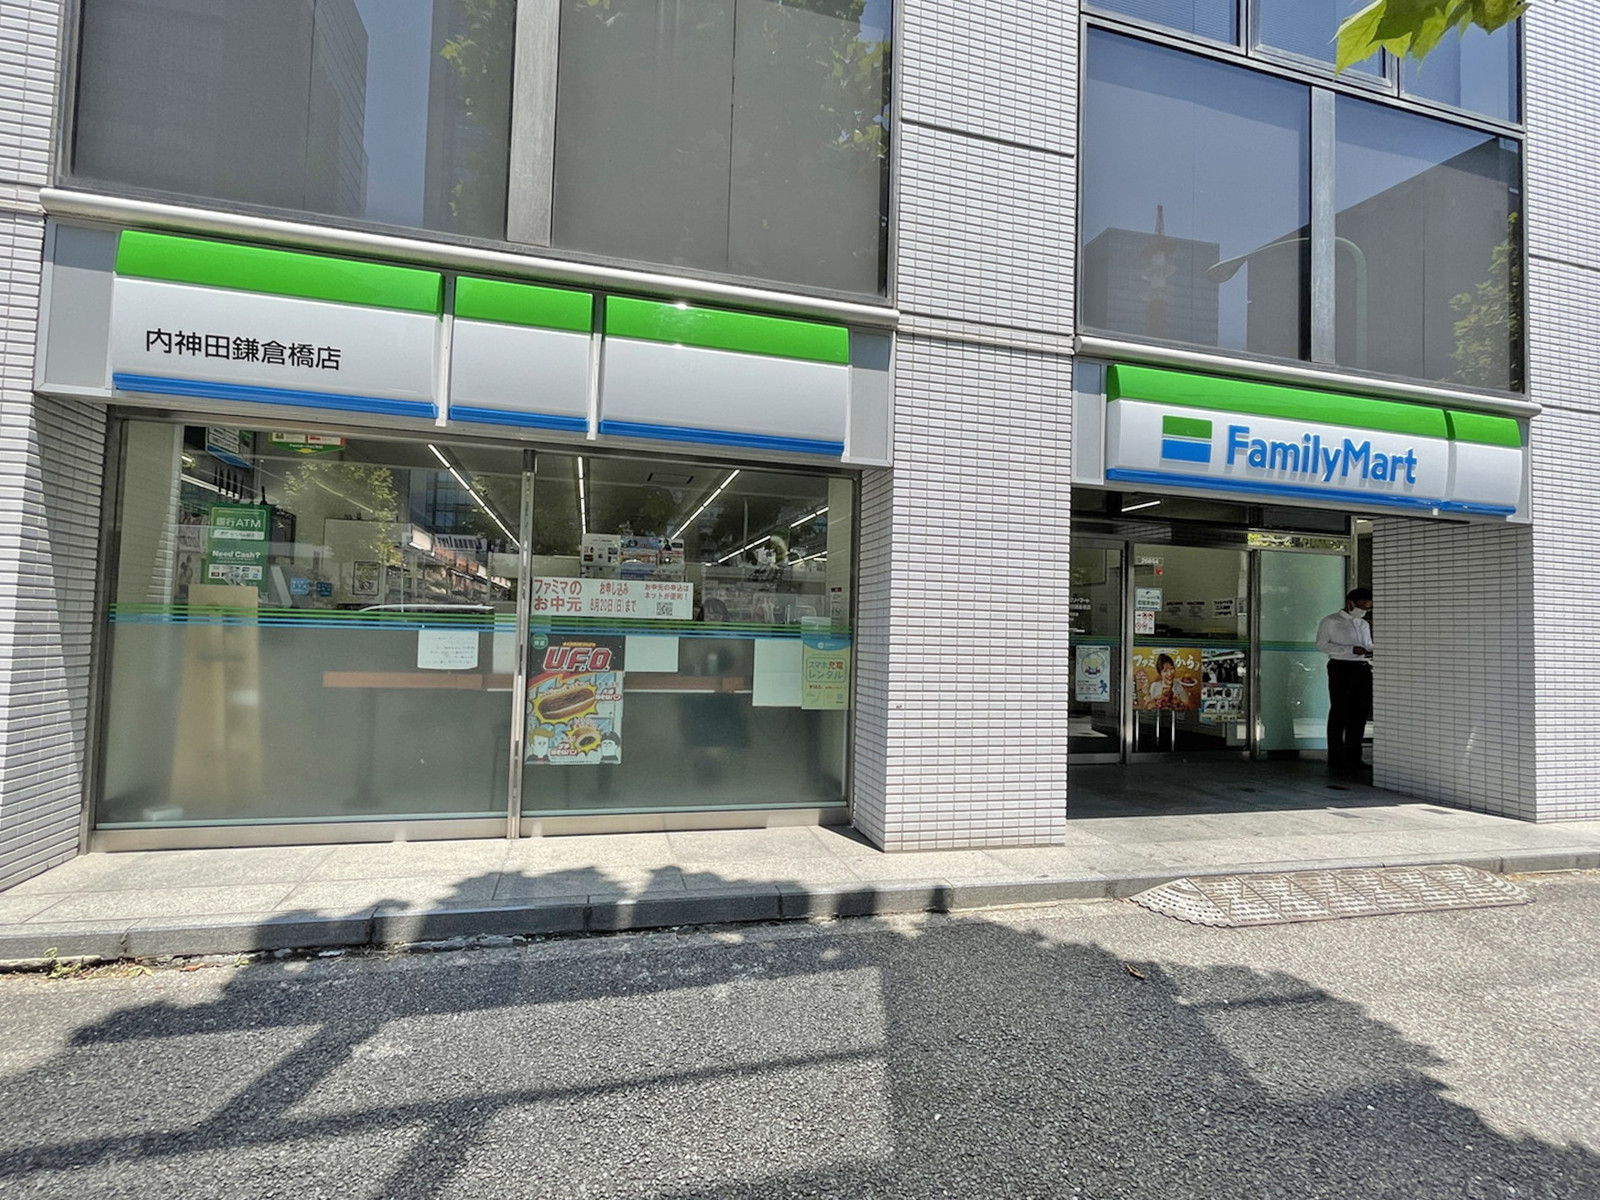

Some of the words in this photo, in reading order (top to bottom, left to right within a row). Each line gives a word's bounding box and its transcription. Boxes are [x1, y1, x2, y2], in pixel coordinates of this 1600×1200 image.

[145, 328, 341, 371] 内神田鎌倉橋店
[1226, 424, 1418, 484] FamilyMart
[215, 517, 261, 528] 銀行ATM
[211, 550, 233, 558] Need
[234, 550, 261, 559] Cash?
[534, 578, 582, 596] ファミマの
[600, 582, 629, 597] お申し込み
[534, 596, 582, 613] お中元
[543, 646, 612, 672] U.F.O.
[808, 661, 844, 670] スマホ充電
[808, 670, 844, 680] レンタル
